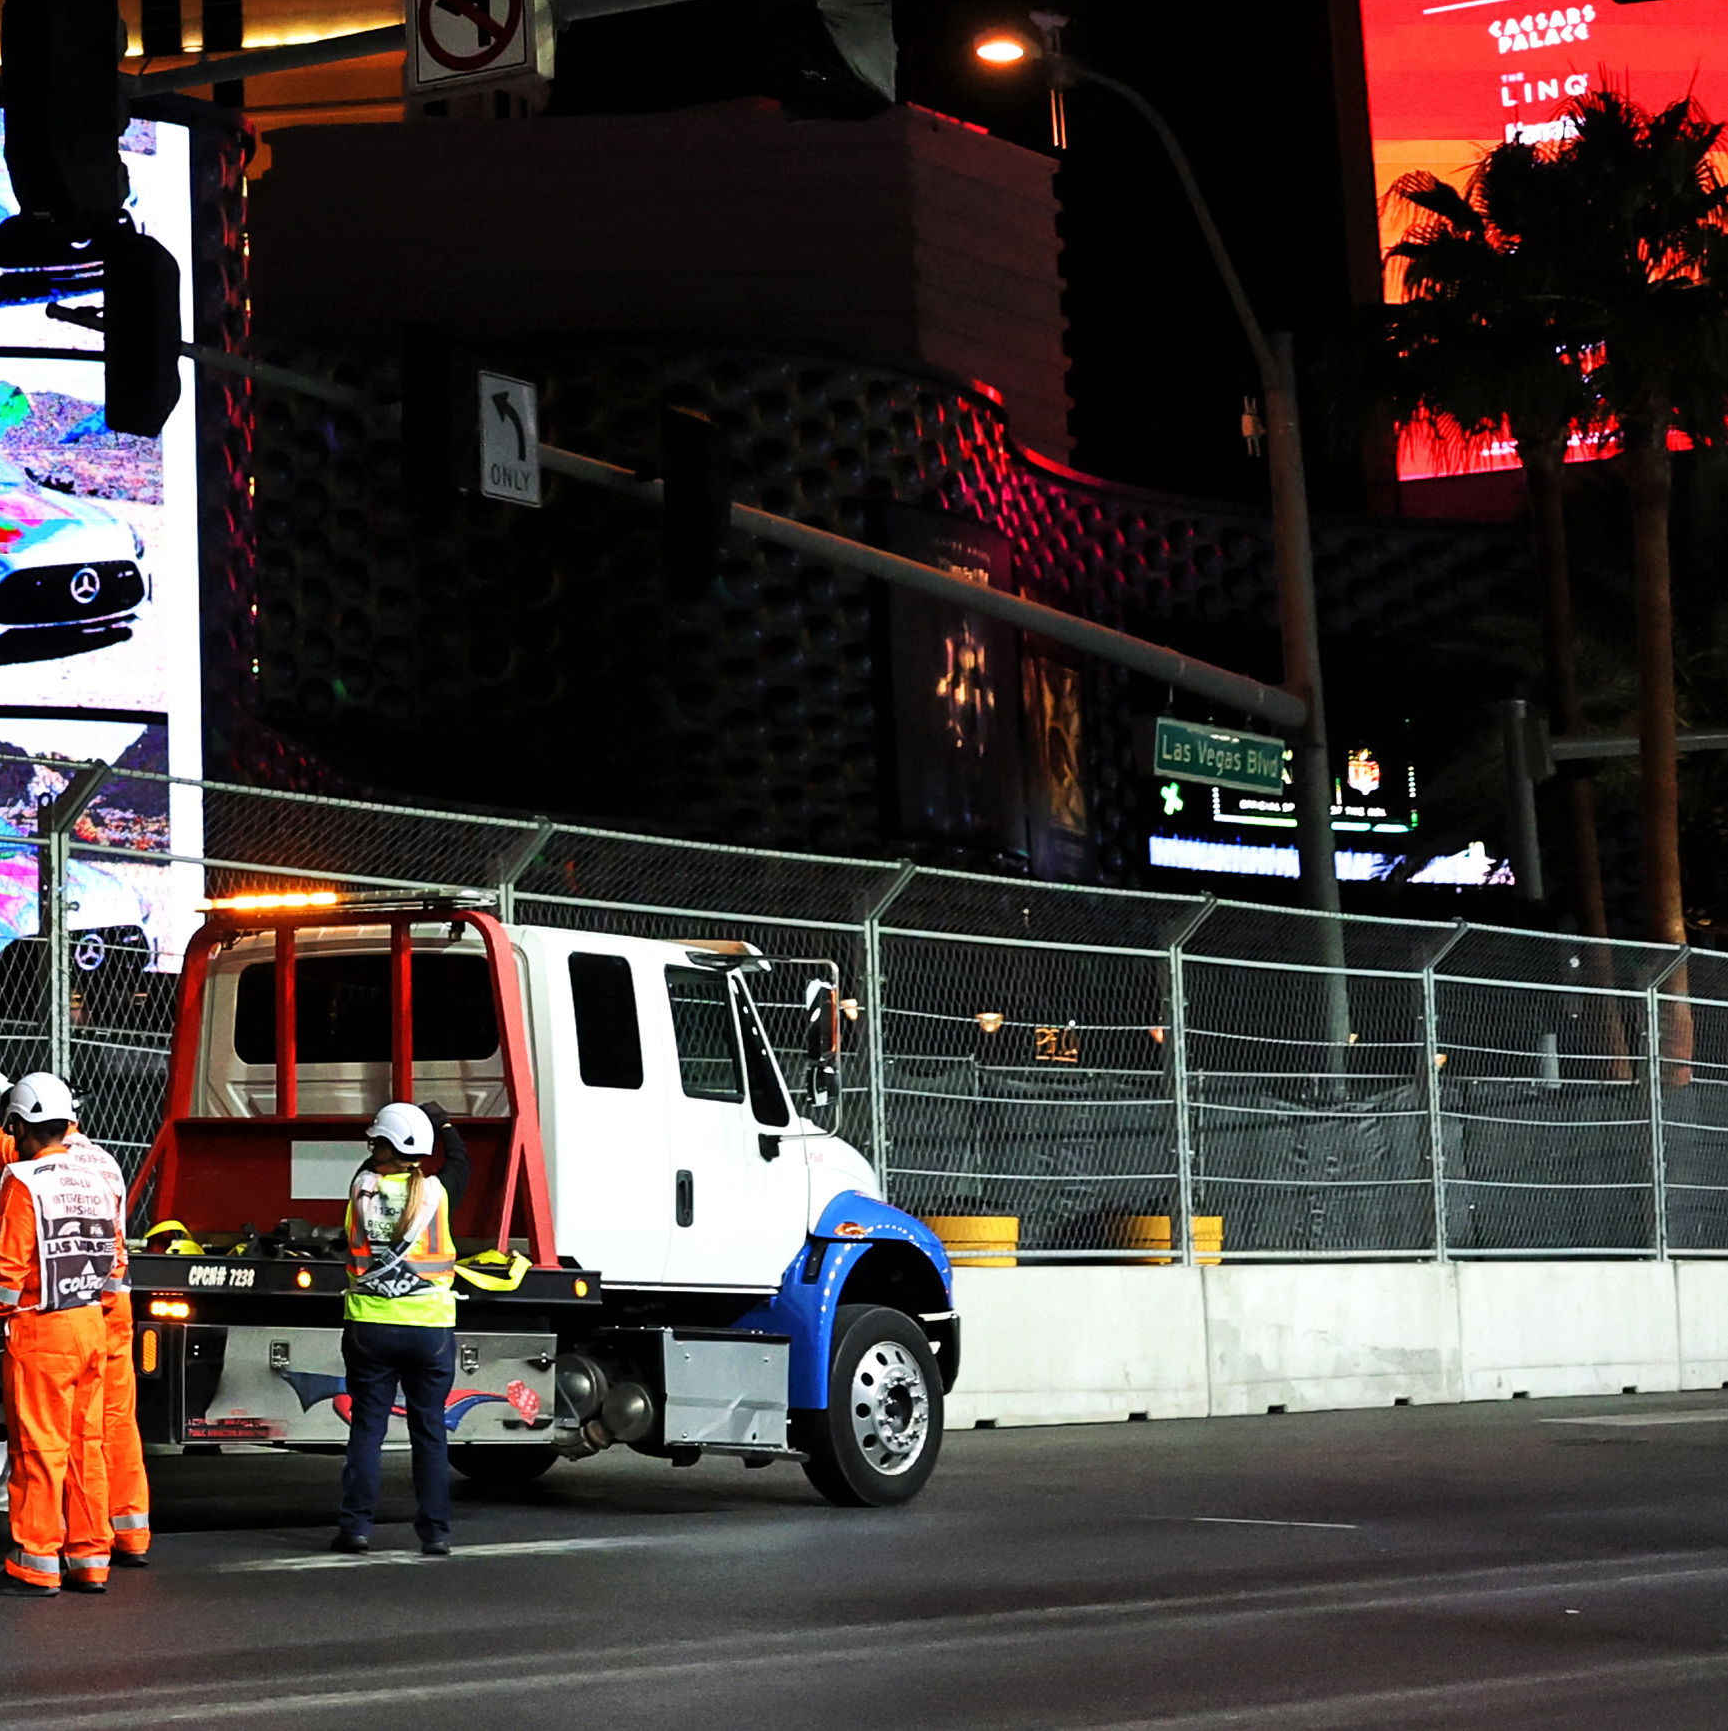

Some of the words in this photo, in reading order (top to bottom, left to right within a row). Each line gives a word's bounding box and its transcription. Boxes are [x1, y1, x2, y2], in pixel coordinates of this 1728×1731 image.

[1488, 4, 1596, 38] CAESARS
[1498, 22, 1590, 54] PALACE
[1501, 74, 1588, 107] LINQ
[491, 464, 531, 490] ONLY
[1161, 734, 1191, 762] Las
[1196, 745, 1242, 776] Vegas
[1246, 749, 1279, 778] Blvd
[47, 1241, 71, 1255] LAS
[188, 1266, 227, 1287] CPCN#
[229, 1269, 255, 1287] 7238
